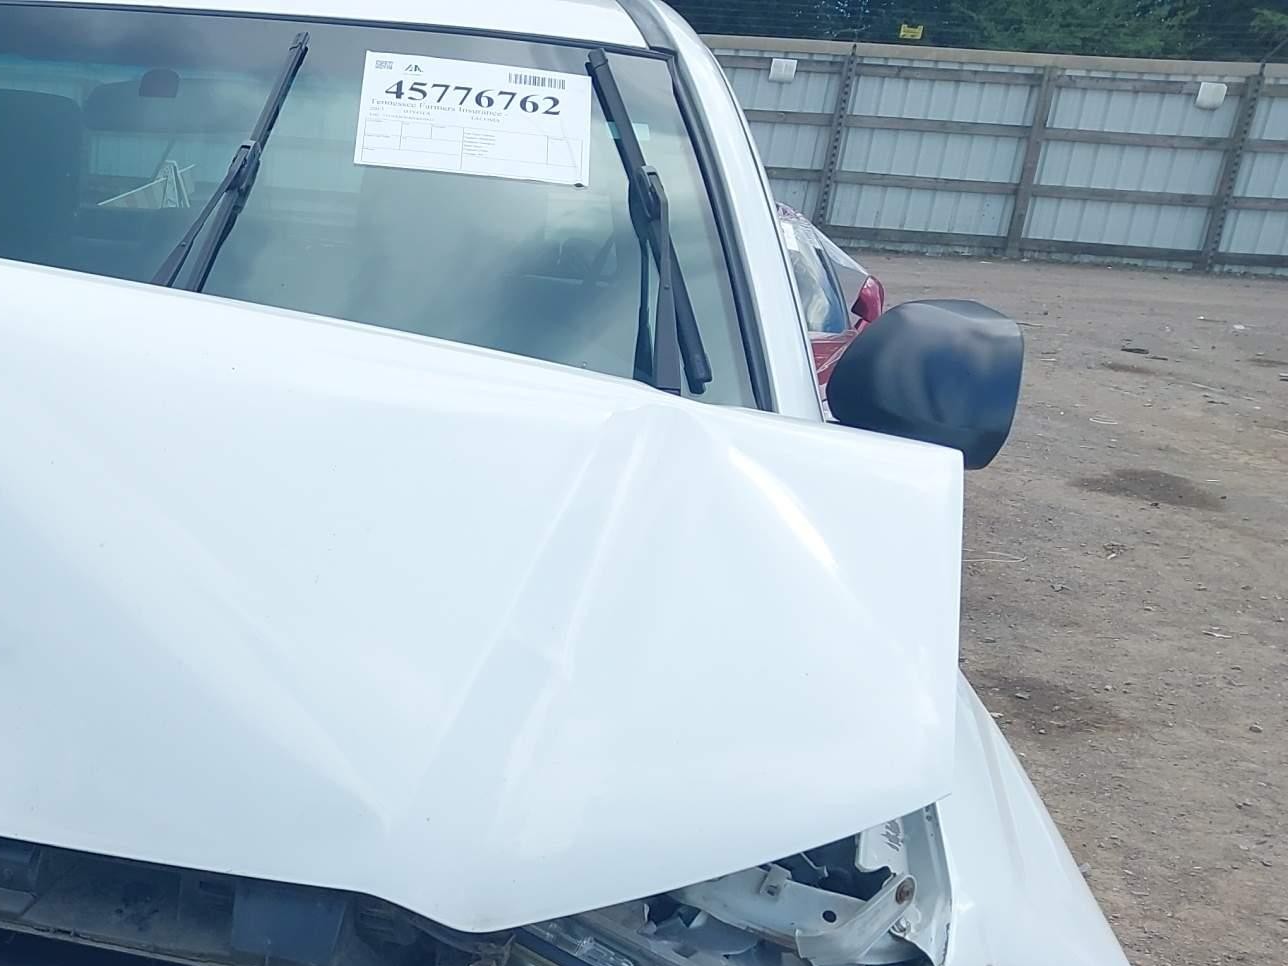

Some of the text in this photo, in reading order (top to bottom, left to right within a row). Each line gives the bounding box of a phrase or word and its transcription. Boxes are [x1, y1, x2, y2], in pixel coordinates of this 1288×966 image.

[371, 98, 417, 109] Tennessee
[458, 106, 503, 117] Insurance
[385, 80, 561, 115] 45776762
